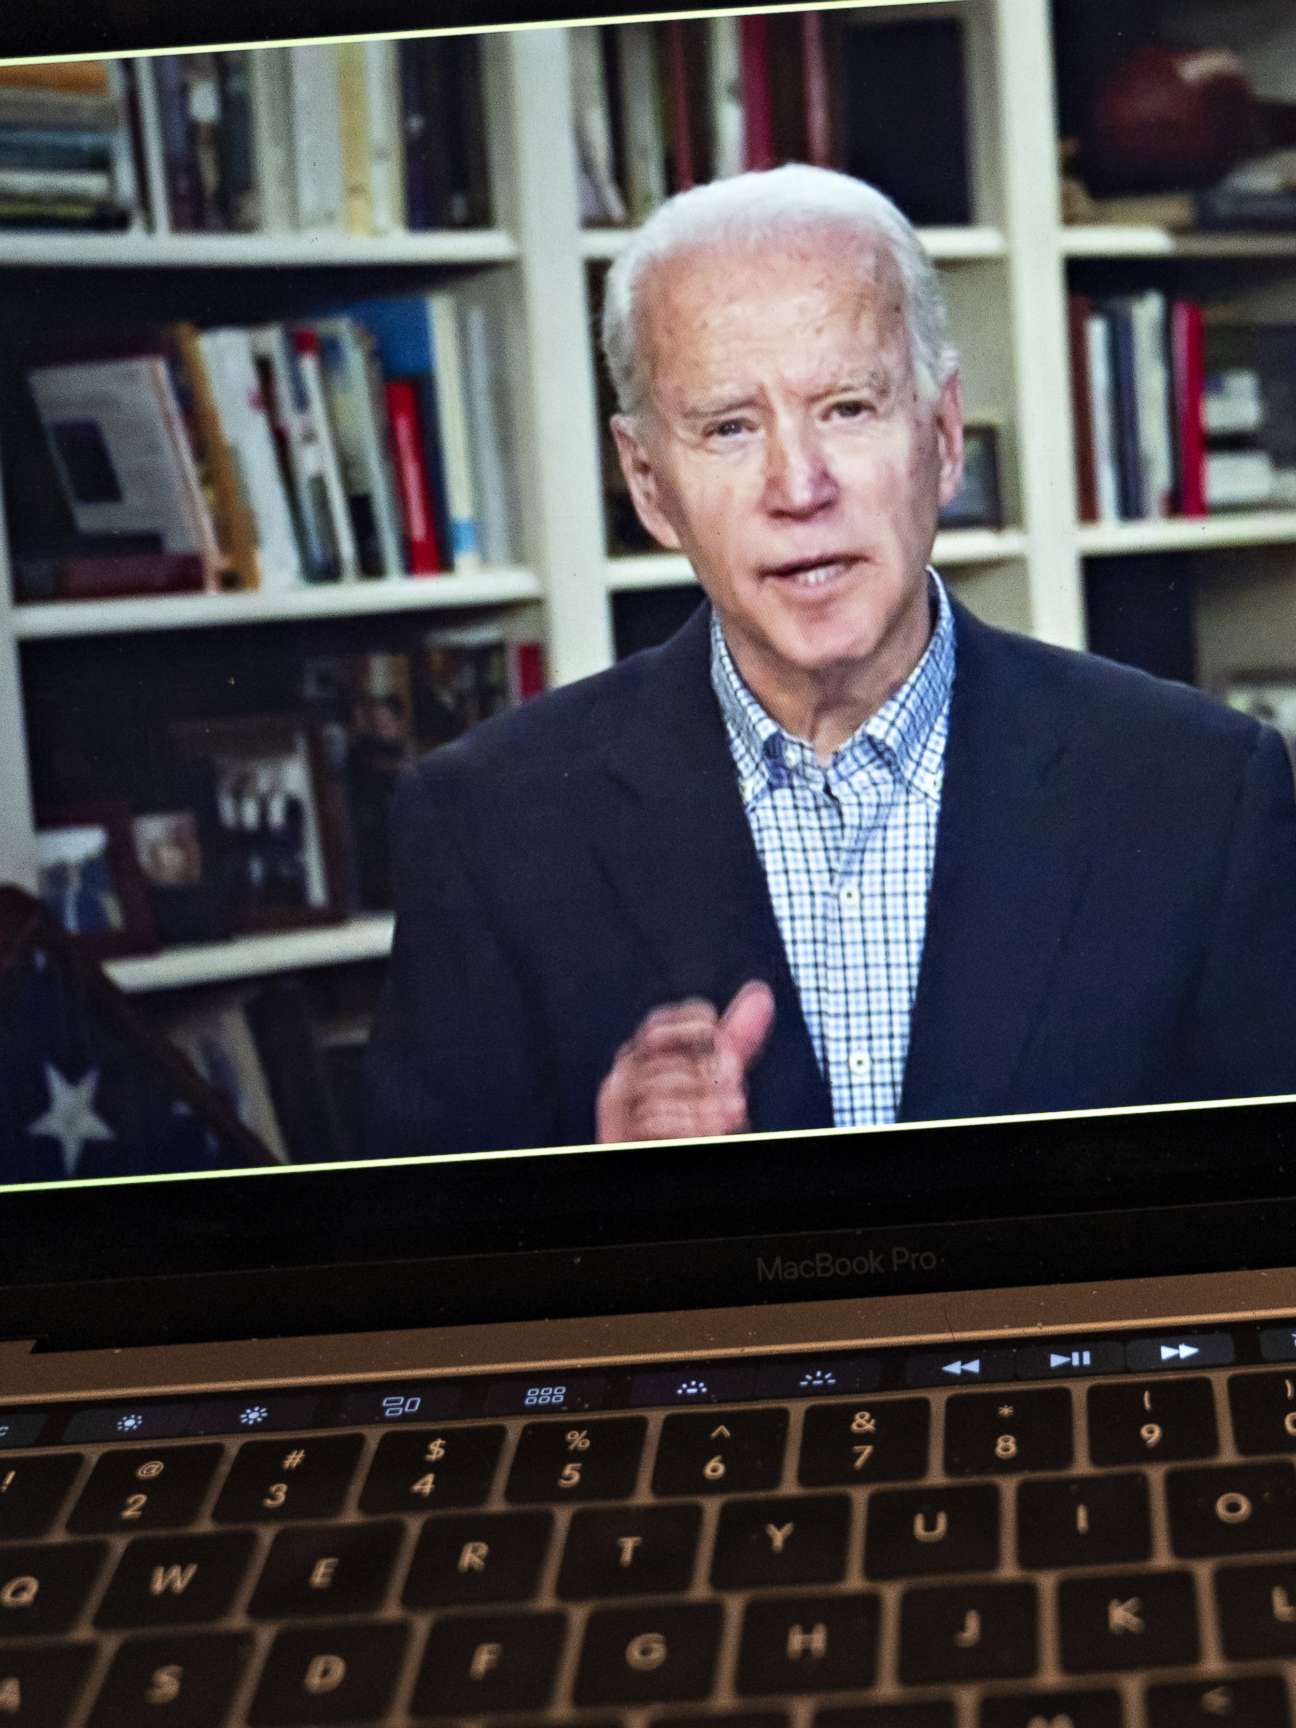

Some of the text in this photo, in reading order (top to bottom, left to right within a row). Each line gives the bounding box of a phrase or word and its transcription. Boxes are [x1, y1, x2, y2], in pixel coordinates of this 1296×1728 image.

[756, 1247, 936, 1281] MacBook Pro
[851, 1411, 875, 1432] &
[1141, 1424, 1161, 1446] 9
[426, 1438, 445, 1461] $
[566, 1430, 590, 1450] %
[995, 1435, 1017, 1458] 8
[137, 1461, 164, 1479] @
[283, 1450, 304, 1469] #
[704, 1456, 725, 1479] 6
[854, 1445, 873, 1468] 7
[412, 1473, 434, 1495] 4
[559, 1463, 581, 1487] 5
[121, 1494, 147, 1519] 2
[264, 1483, 287, 1507] 3
[1216, 1493, 1251, 1522] O
[914, 1512, 947, 1541] U
[1077, 1505, 1088, 1532] I
[619, 1537, 641, 1567] T
[767, 1523, 792, 1552] Y
[459, 1542, 488, 1572] R
[151, 1565, 197, 1594] W
[311, 1558, 337, 1589] E
[1109, 1599, 1141, 1632] K
[1272, 1587, 1295, 1623] L
[788, 1624, 826, 1658] H
[958, 1610, 980, 1648] J
[471, 1644, 499, 1679] F
[626, 1633, 666, 1671] G
[150, 1665, 181, 1704] S
[305, 1655, 345, 1694] D
